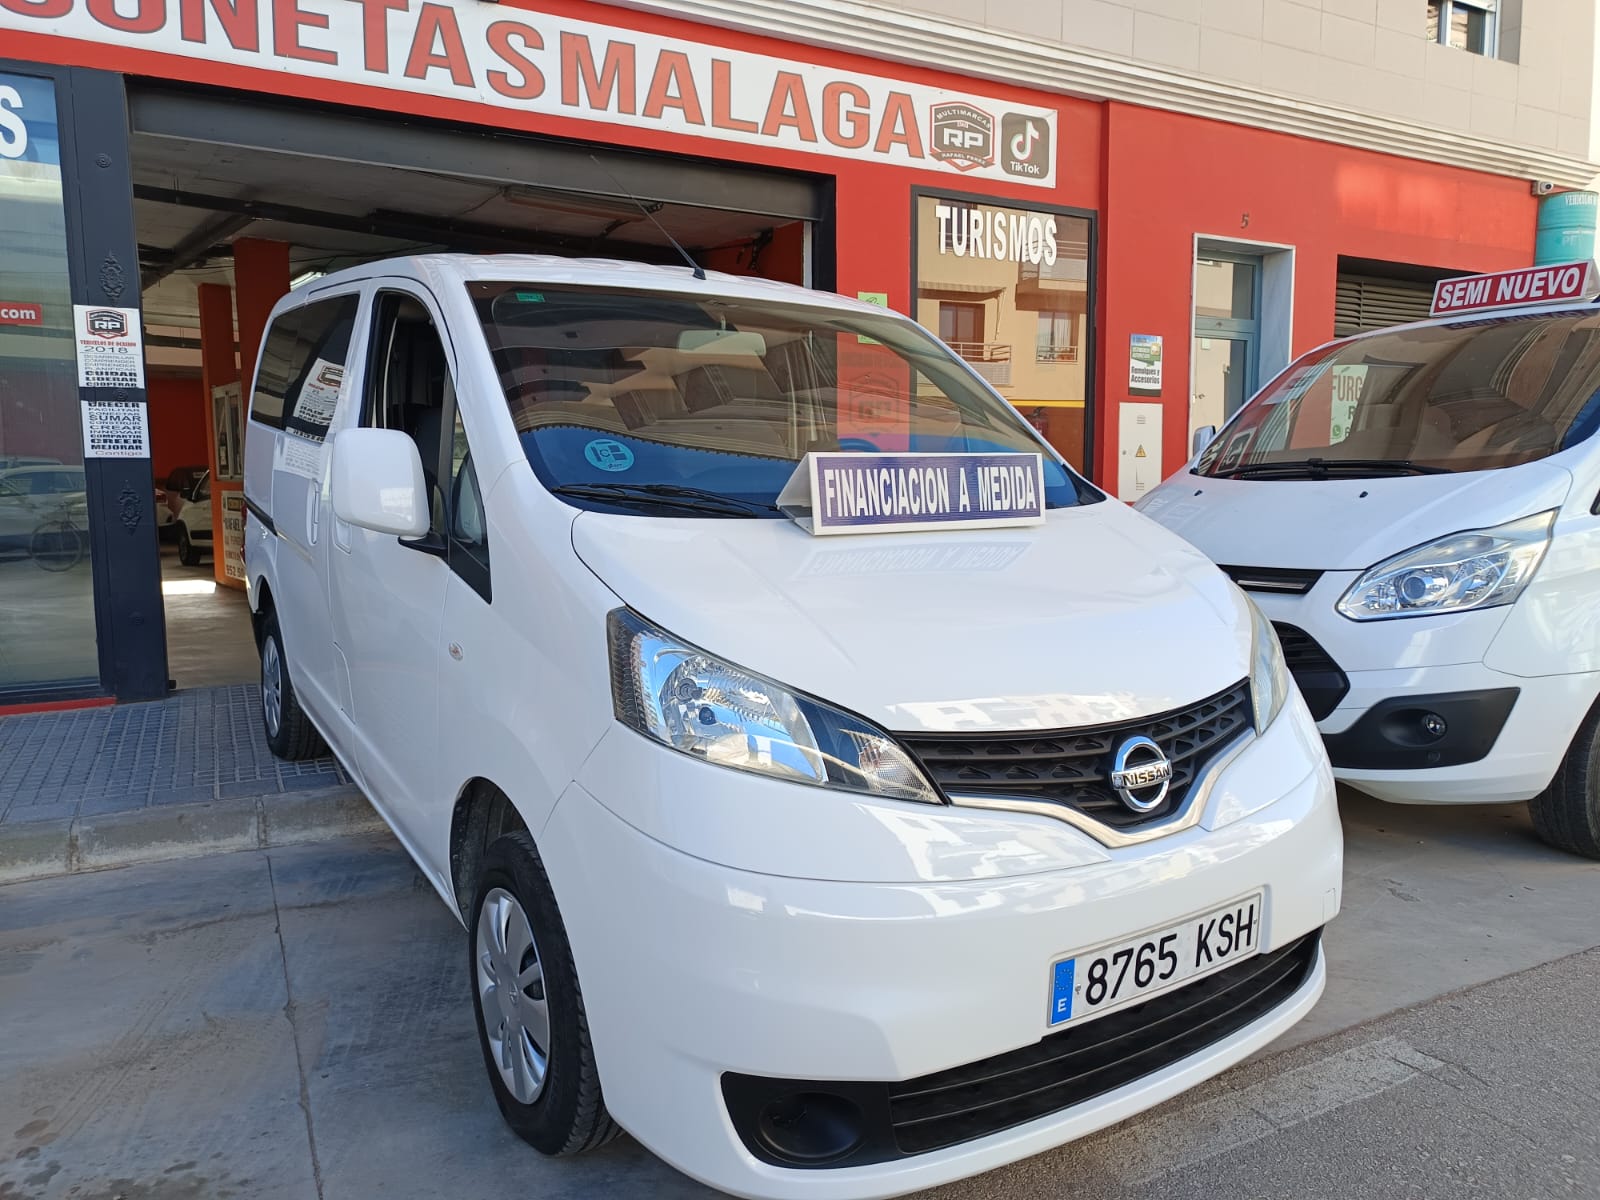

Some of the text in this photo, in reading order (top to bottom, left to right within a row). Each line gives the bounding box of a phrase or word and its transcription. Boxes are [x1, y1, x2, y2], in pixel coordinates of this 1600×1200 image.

[936, 109, 991, 129] MULTIMARCAS
[943, 127, 984, 149] RP
[1009, 161, 1040, 175] TikTok
[1240, 213, 1250, 230] 5
[935, 204, 1058, 267] TURISMOS
[1438, 267, 1581, 309] SEMI NUEVO
[94, 320, 121, 330] RP
[84, 346, 129, 354] 2018
[1131, 374, 1161, 384] Accesorios
[823, 465, 1037, 518] FINANCIACION A MEDIDA
[1123, 763, 1171, 786] NISSAN
[1057, 903, 1255, 1013] E 8765 KSH
